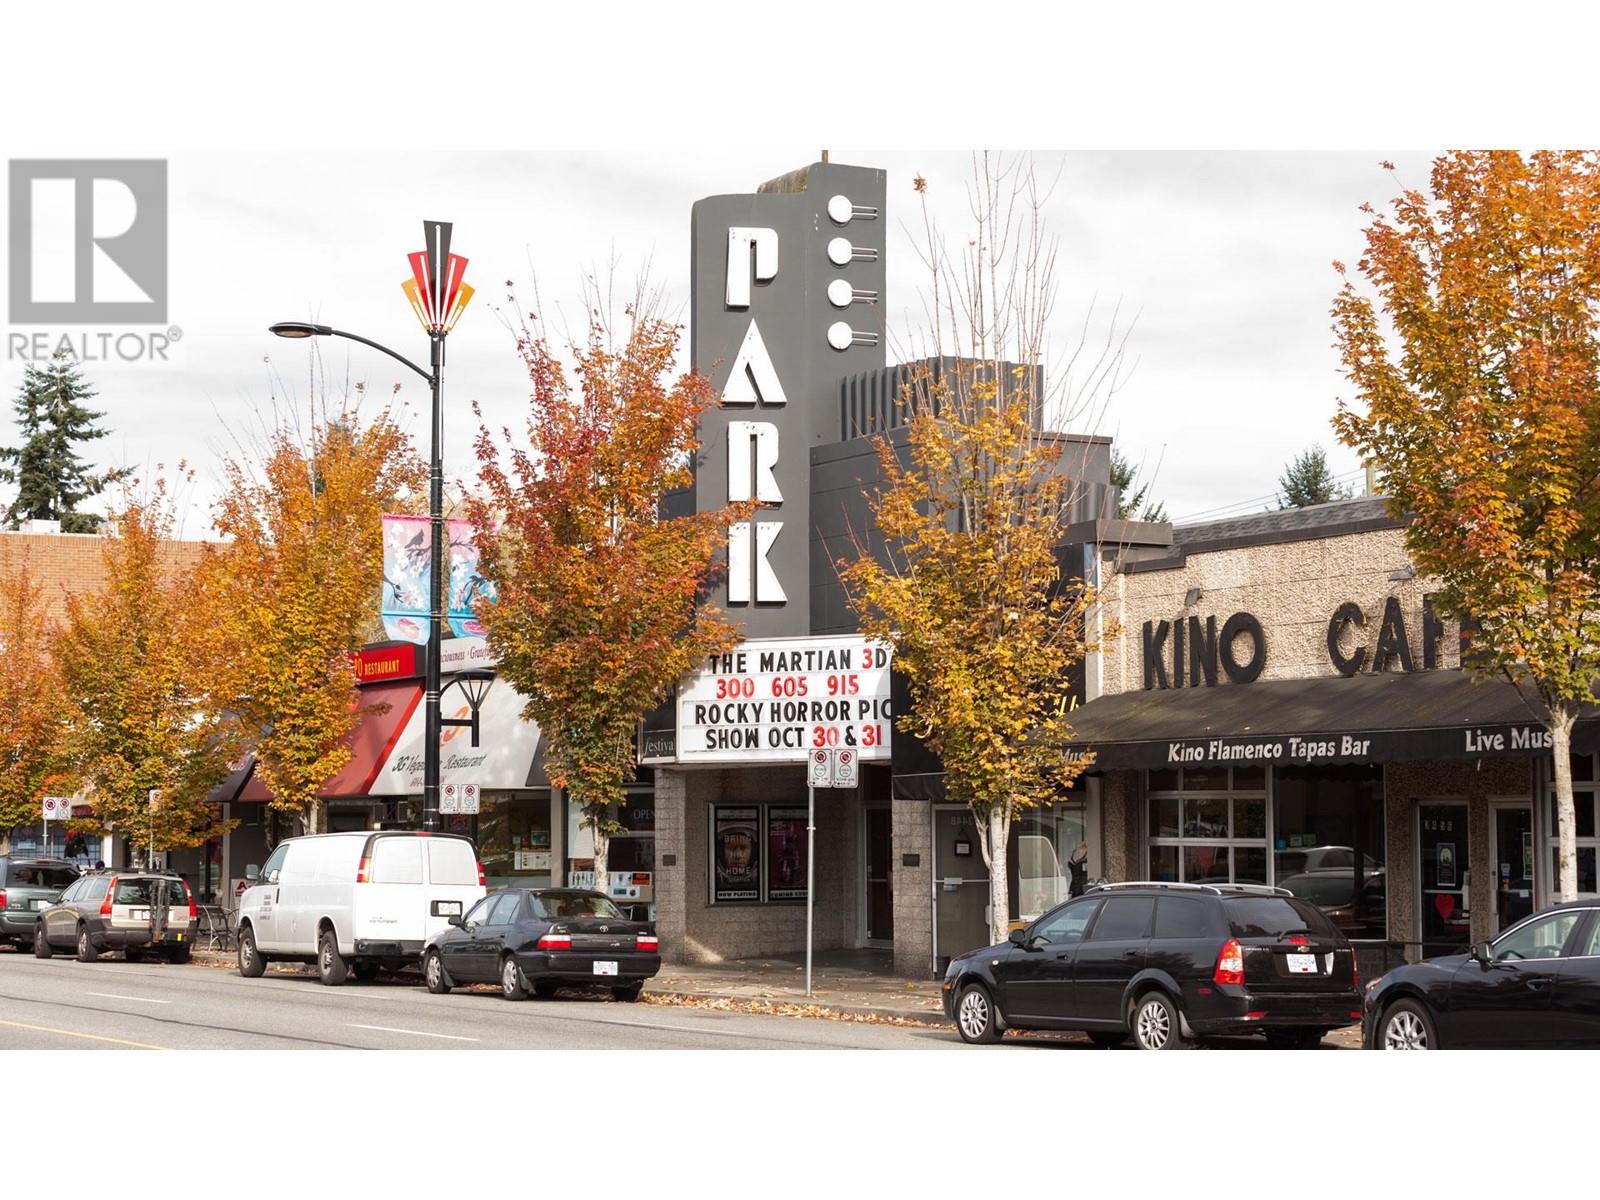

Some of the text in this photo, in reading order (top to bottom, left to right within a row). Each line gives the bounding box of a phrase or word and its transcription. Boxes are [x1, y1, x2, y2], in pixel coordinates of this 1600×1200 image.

[719, 226, 788, 603] PARK
[1142, 592, 1482, 690] KINO CAF
[364, 660, 399, 676] RESTAURANT
[709, 648, 887, 674] THE MARTIAN 3D
[716, 674, 860, 699] 300 605 915
[695, 699, 892, 725] ROCKY HORROR PIC
[705, 724, 882, 749] SHOW OCT 30 & 31
[1167, 735, 1370, 763] Kino Flamenco Tapas Bar
[1465, 727, 1554, 752] Live Mus
